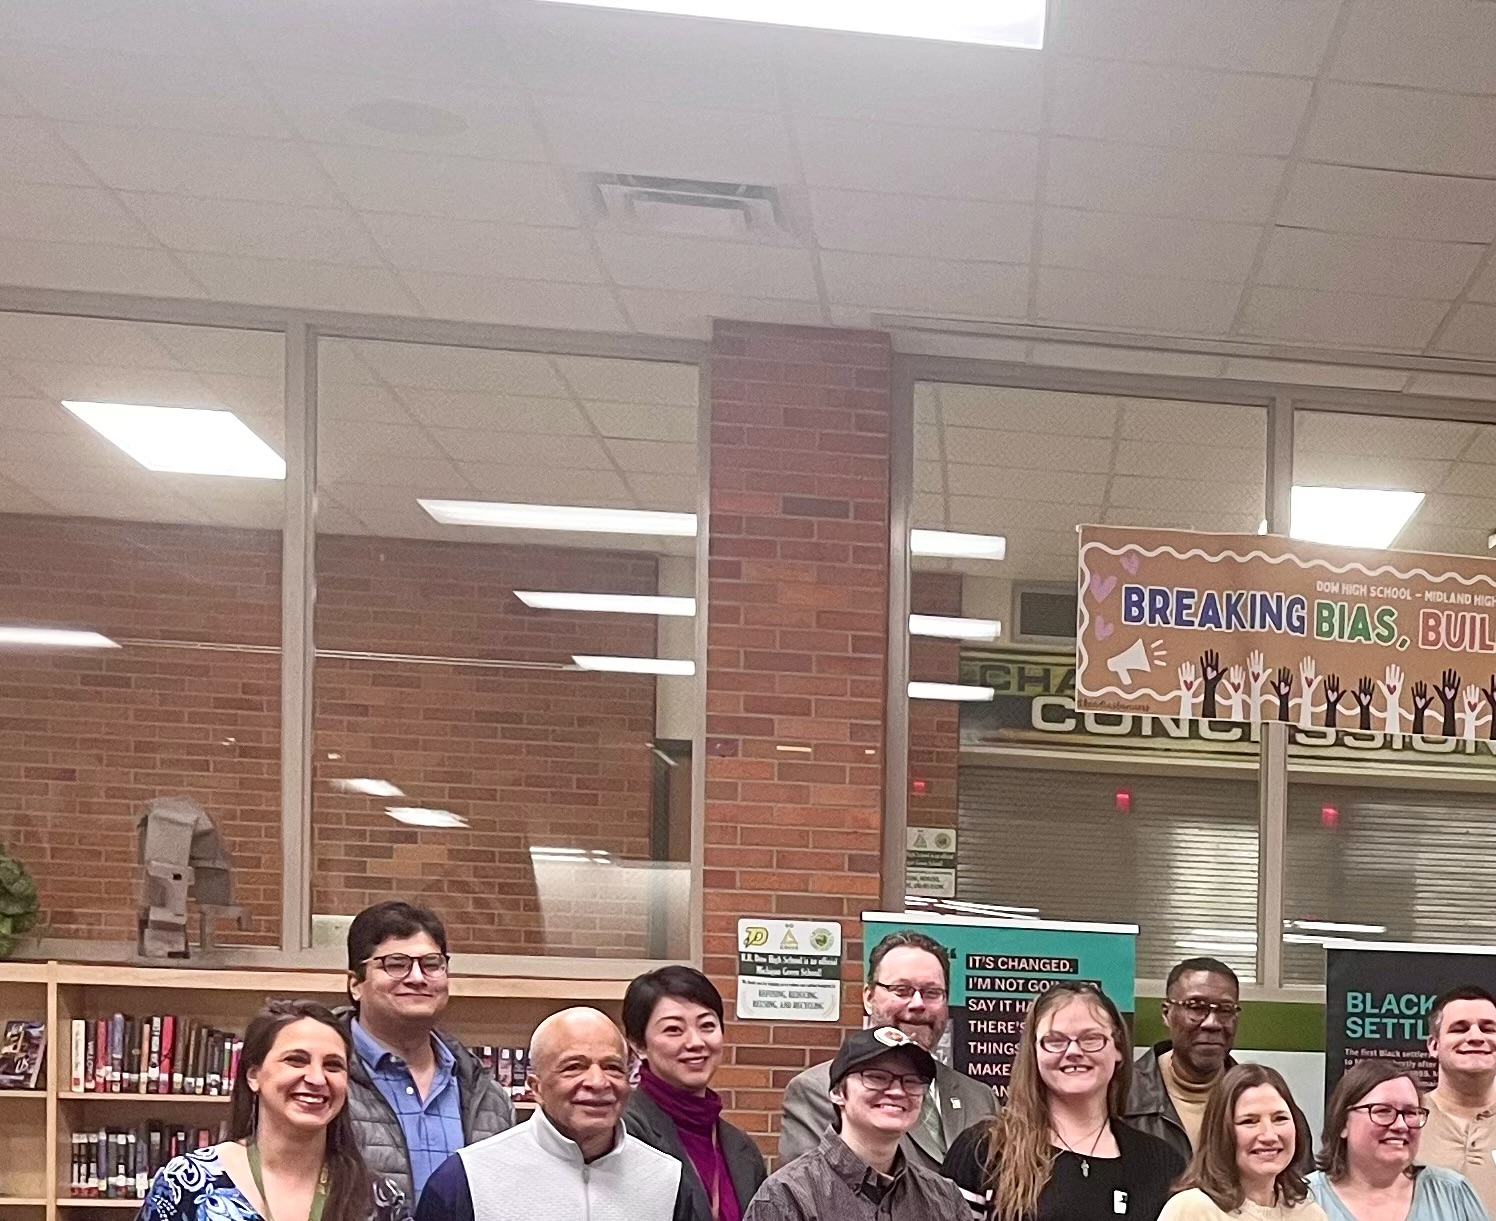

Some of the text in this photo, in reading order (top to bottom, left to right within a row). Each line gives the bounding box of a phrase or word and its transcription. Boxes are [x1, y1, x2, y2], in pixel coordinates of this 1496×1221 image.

[1316, 580, 1339, 593] DOW
[1342, 582, 1368, 597] HIGH
[1370, 585, 1412, 600] SCHOOL
[1424, 591, 1472, 605] MIDLAND
[1122, 584, 1308, 637] BREAKING
[1314, 600, 1410, 651] BIAS,
[968, 956, 1074, 972] IT'S CHANGED.
[968, 978, 991, 990] I'M
[994, 978, 1026, 991] NOT
[968, 999, 996, 1011] SAY
[999, 1000, 1013, 1012] IT
[1346, 992, 1438, 1015] BLACK
[1344, 1048, 1359, 1056] The
[1361, 1048, 1377, 1057] first
[1379, 1049, 1400, 1058] Black
[968, 1063, 1012, 1076] MAKE
